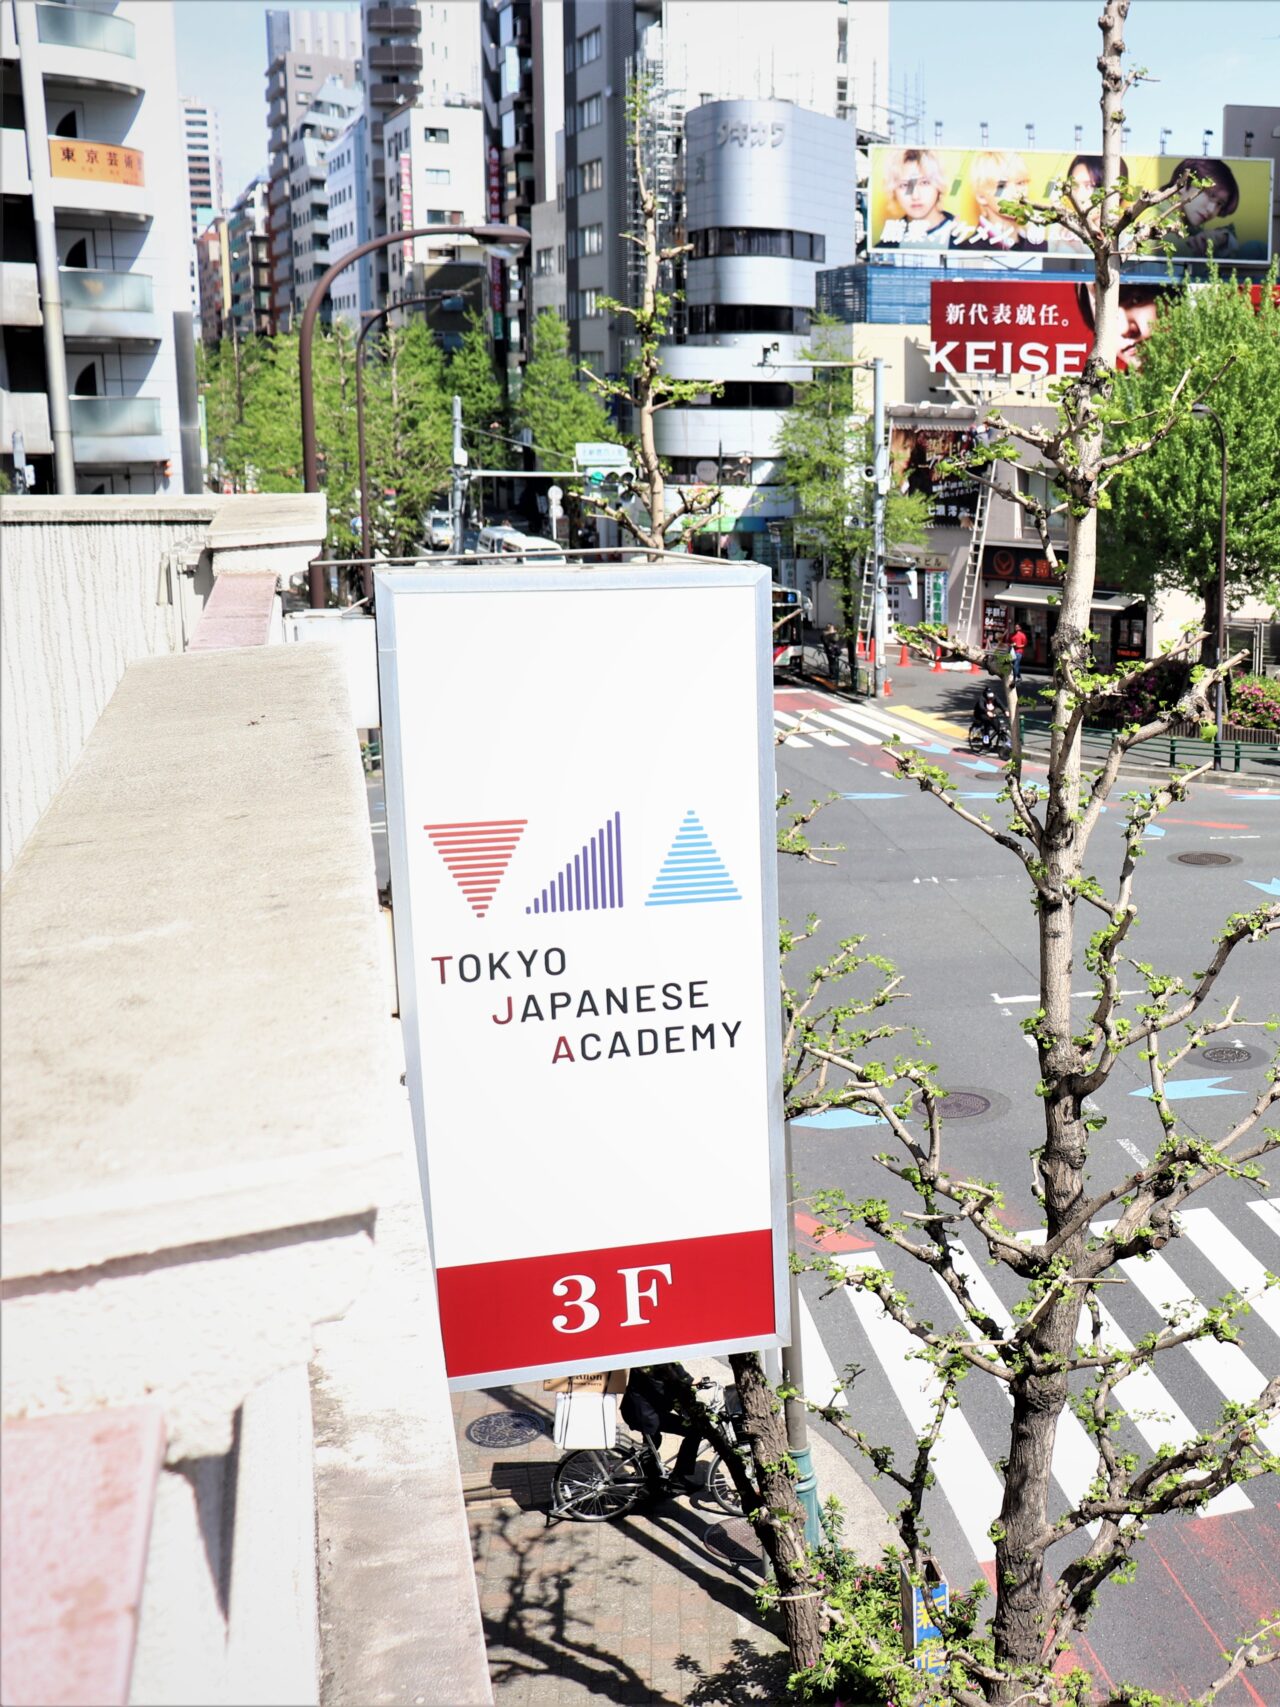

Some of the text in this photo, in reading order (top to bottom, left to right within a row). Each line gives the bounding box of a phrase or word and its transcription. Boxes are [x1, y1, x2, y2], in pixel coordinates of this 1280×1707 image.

[945, 303, 1069, 327] 新代表就任。
[431, 947, 567, 985] TOKYO
[492, 980, 709, 1025] JAPANESE
[551, 1020, 742, 1064] ACADEMY
